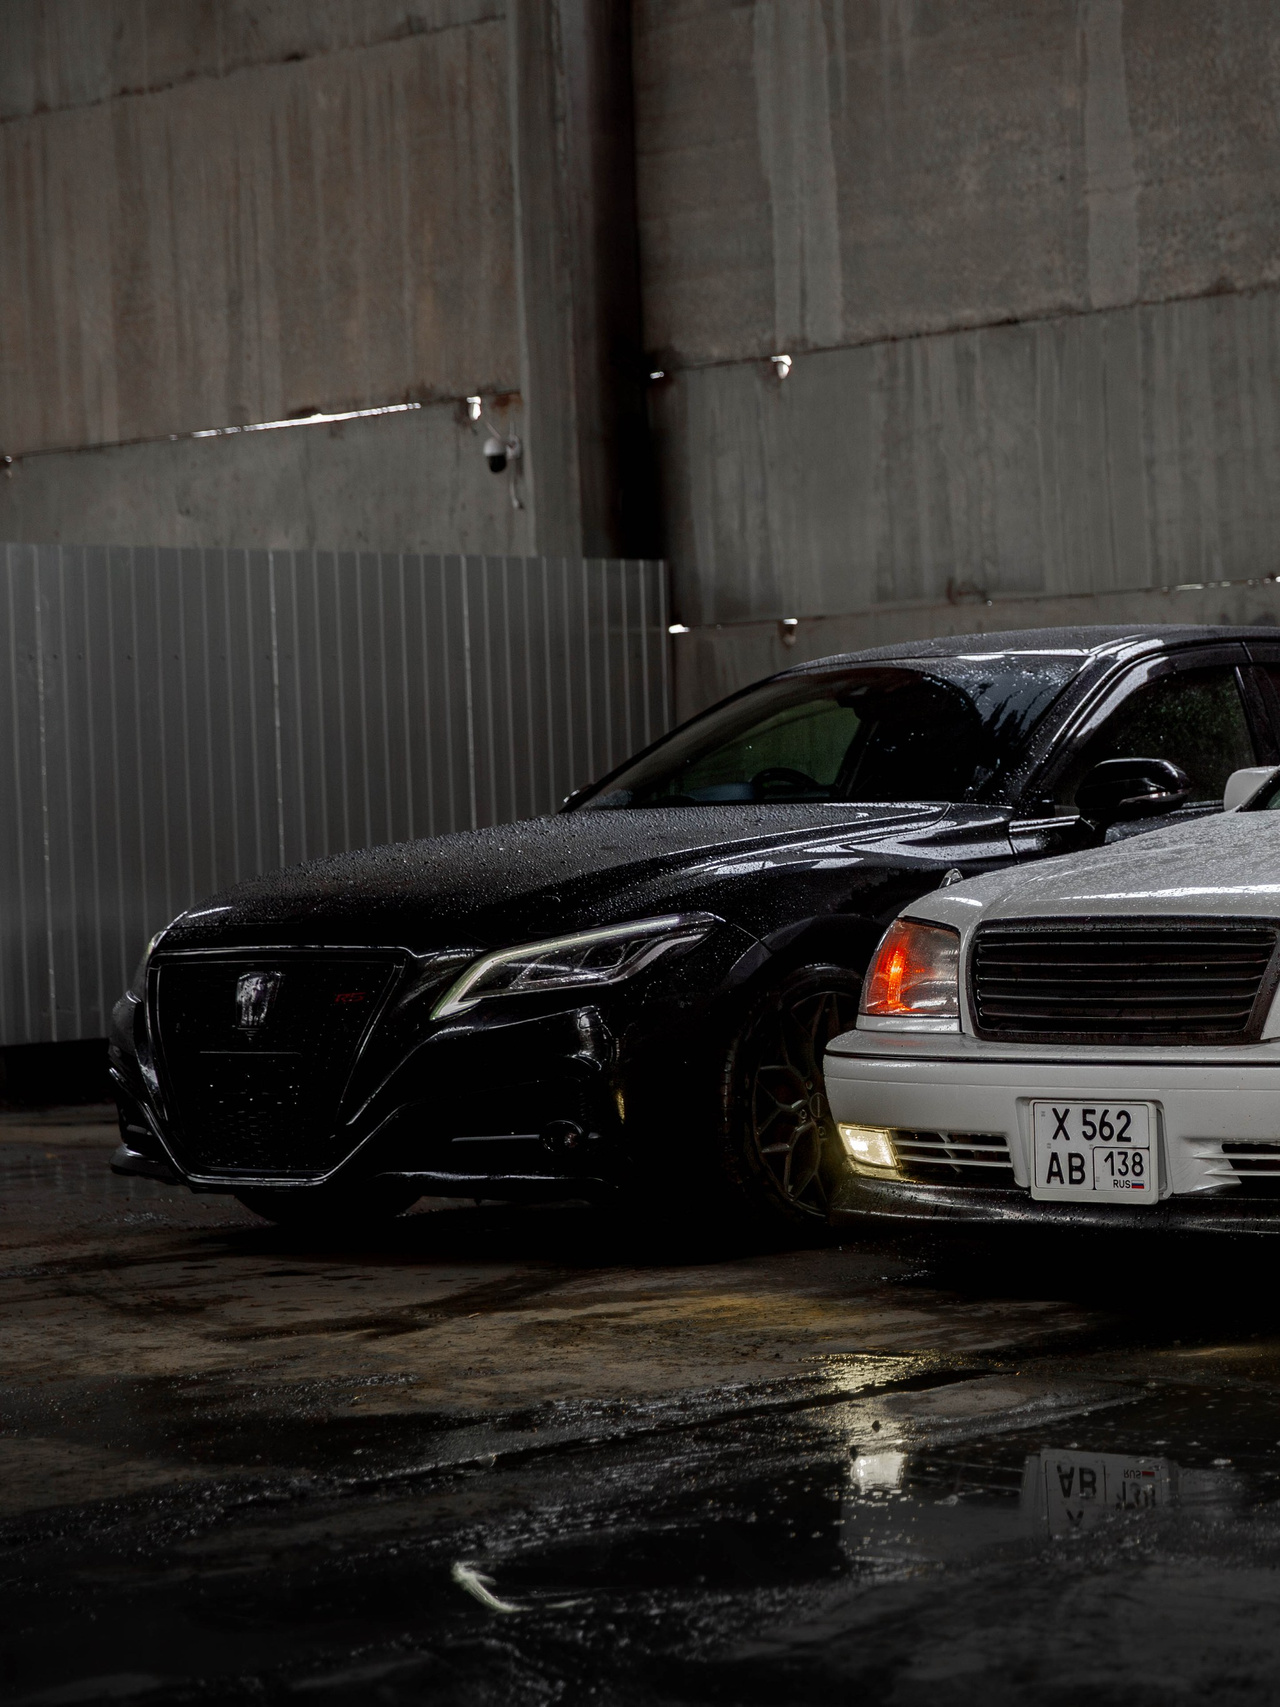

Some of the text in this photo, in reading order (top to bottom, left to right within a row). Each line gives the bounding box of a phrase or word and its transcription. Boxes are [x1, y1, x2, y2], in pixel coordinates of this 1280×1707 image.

[1052, 1107, 1132, 1143] X 562
[1046, 1151, 1086, 1185] AB
[1103, 1151, 1144, 1177] 138
[1113, 1179, 1131, 1188] RUS
